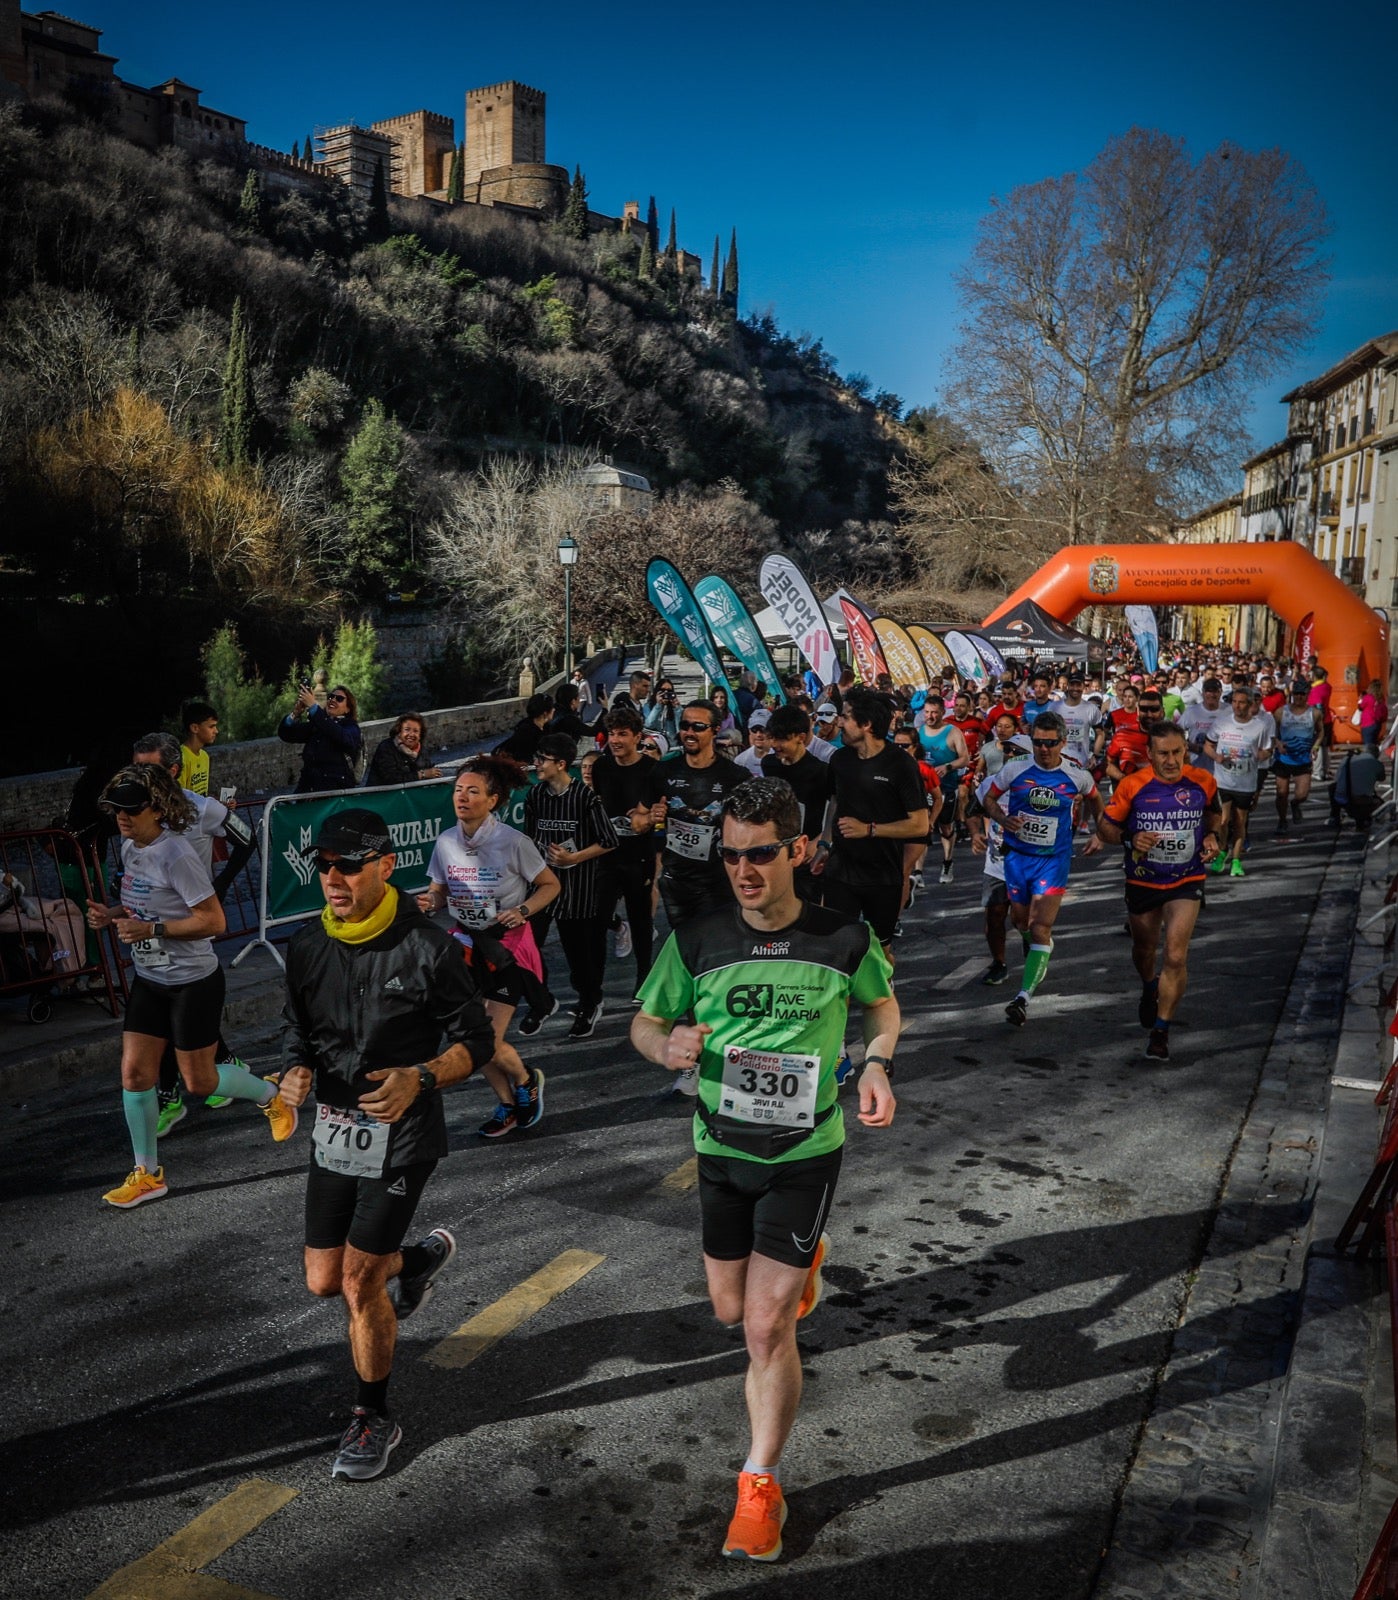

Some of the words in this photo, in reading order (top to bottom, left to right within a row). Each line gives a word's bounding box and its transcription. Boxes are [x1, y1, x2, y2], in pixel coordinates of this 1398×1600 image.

[1124, 568, 1198, 577] AYUNTAMIENTO
[1215, 566, 1264, 575] GRANADA
[1134, 577, 1187, 588] Concejalía
[1190, 578, 1203, 586] de
[1206, 577, 1251, 586] Deportes
[1136, 811, 1164, 820] DONA
[1022, 821, 1049, 835] 482
[1137, 820, 1174, 831] DONA
[388, 817, 442, 848] RURAL
[675, 829, 700, 846] 248
[1155, 839, 1187, 852] 456
[457, 908, 488, 921] 354
[751, 944, 789, 956] Altium
[776, 983, 800, 991] Carrera
[776, 993, 806, 1006] AVE
[774, 1007, 822, 1022] MARÍA
[740, 1050, 780, 1064] Carrera
[740, 1059, 781, 1072] Solidaria
[739, 1068, 799, 1098] 330
[320, 1105, 329, 1120] 9
[327, 1122, 373, 1151] 710
